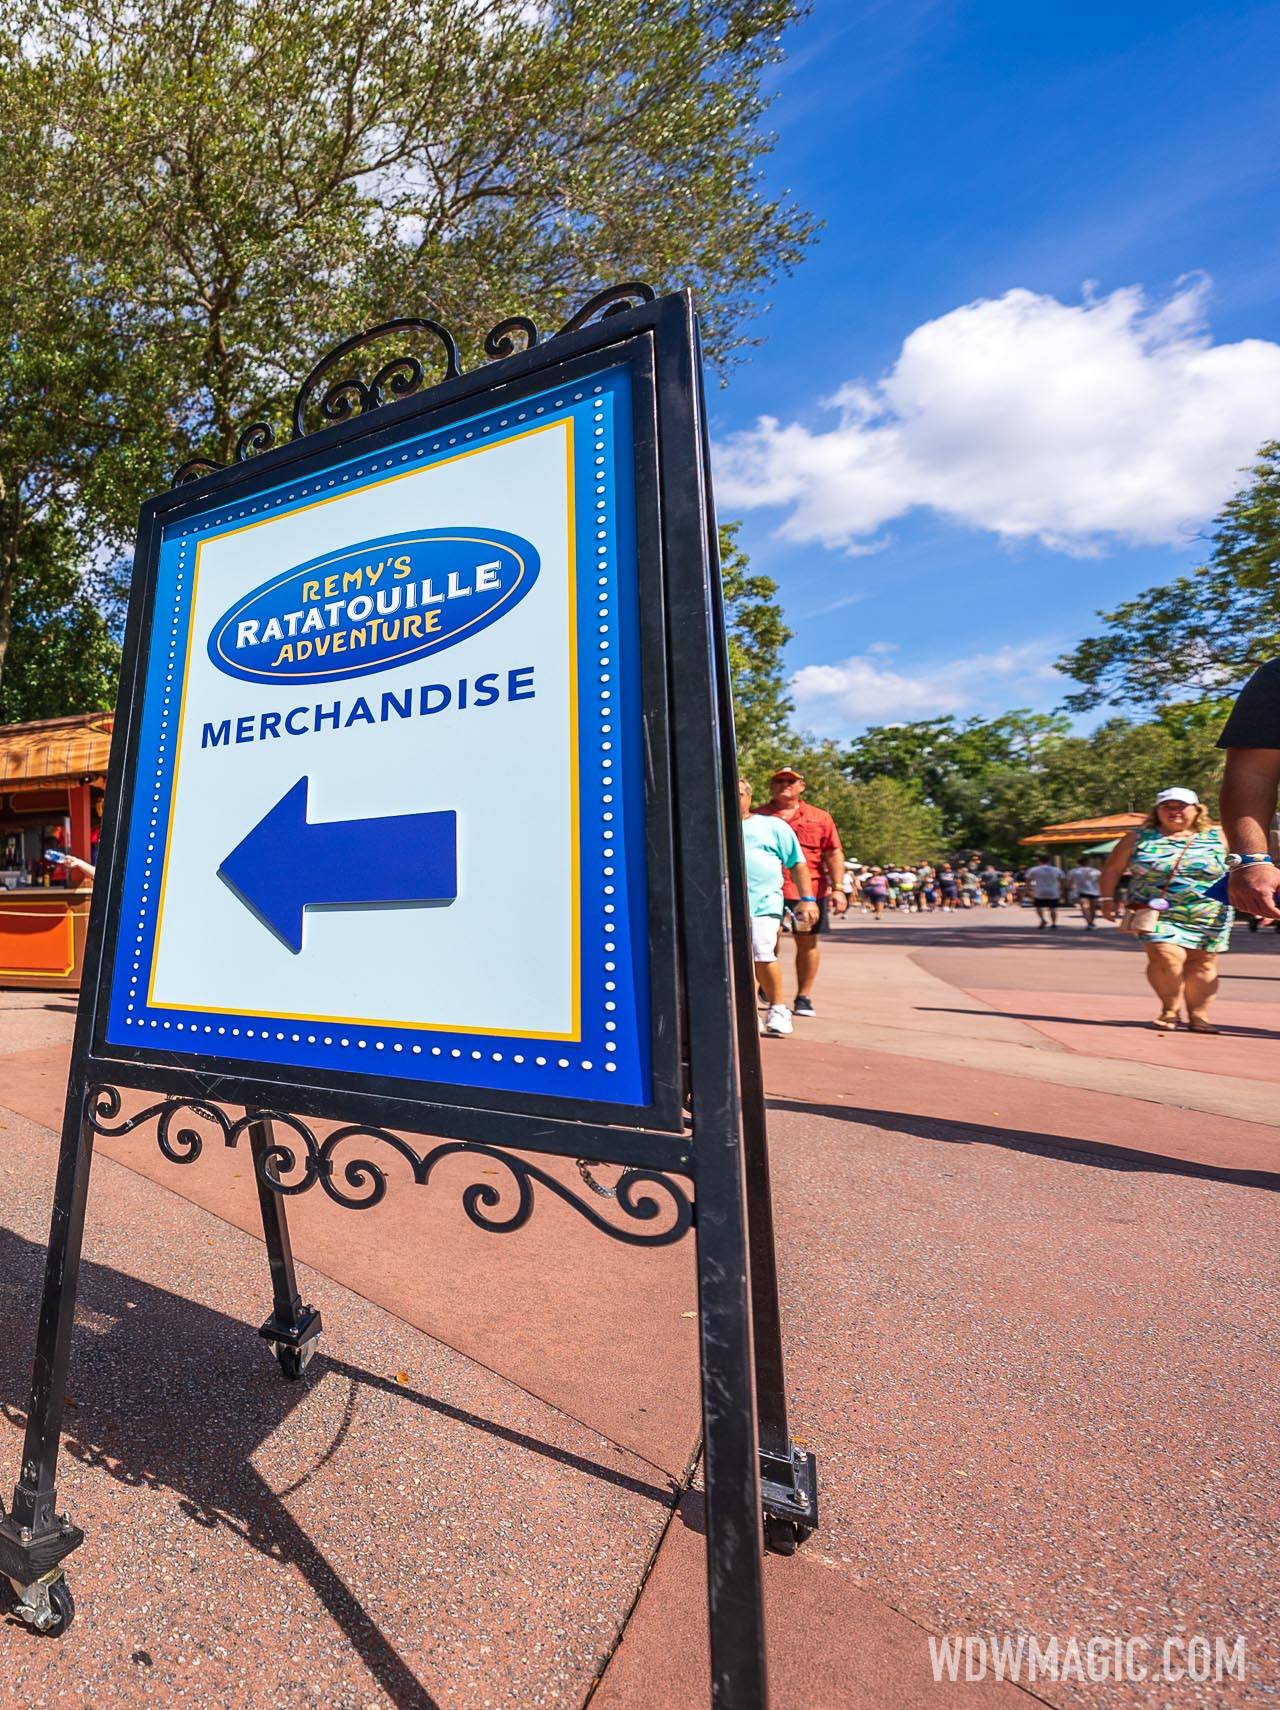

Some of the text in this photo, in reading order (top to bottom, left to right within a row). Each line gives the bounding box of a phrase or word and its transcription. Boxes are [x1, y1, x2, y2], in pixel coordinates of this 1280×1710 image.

[235, 560, 502, 649] RATATOUILLE
[302, 555, 412, 603] REMY'S
[271, 610, 442, 666] ADVENTURE
[200, 665, 536, 748] MERCHANDISE
